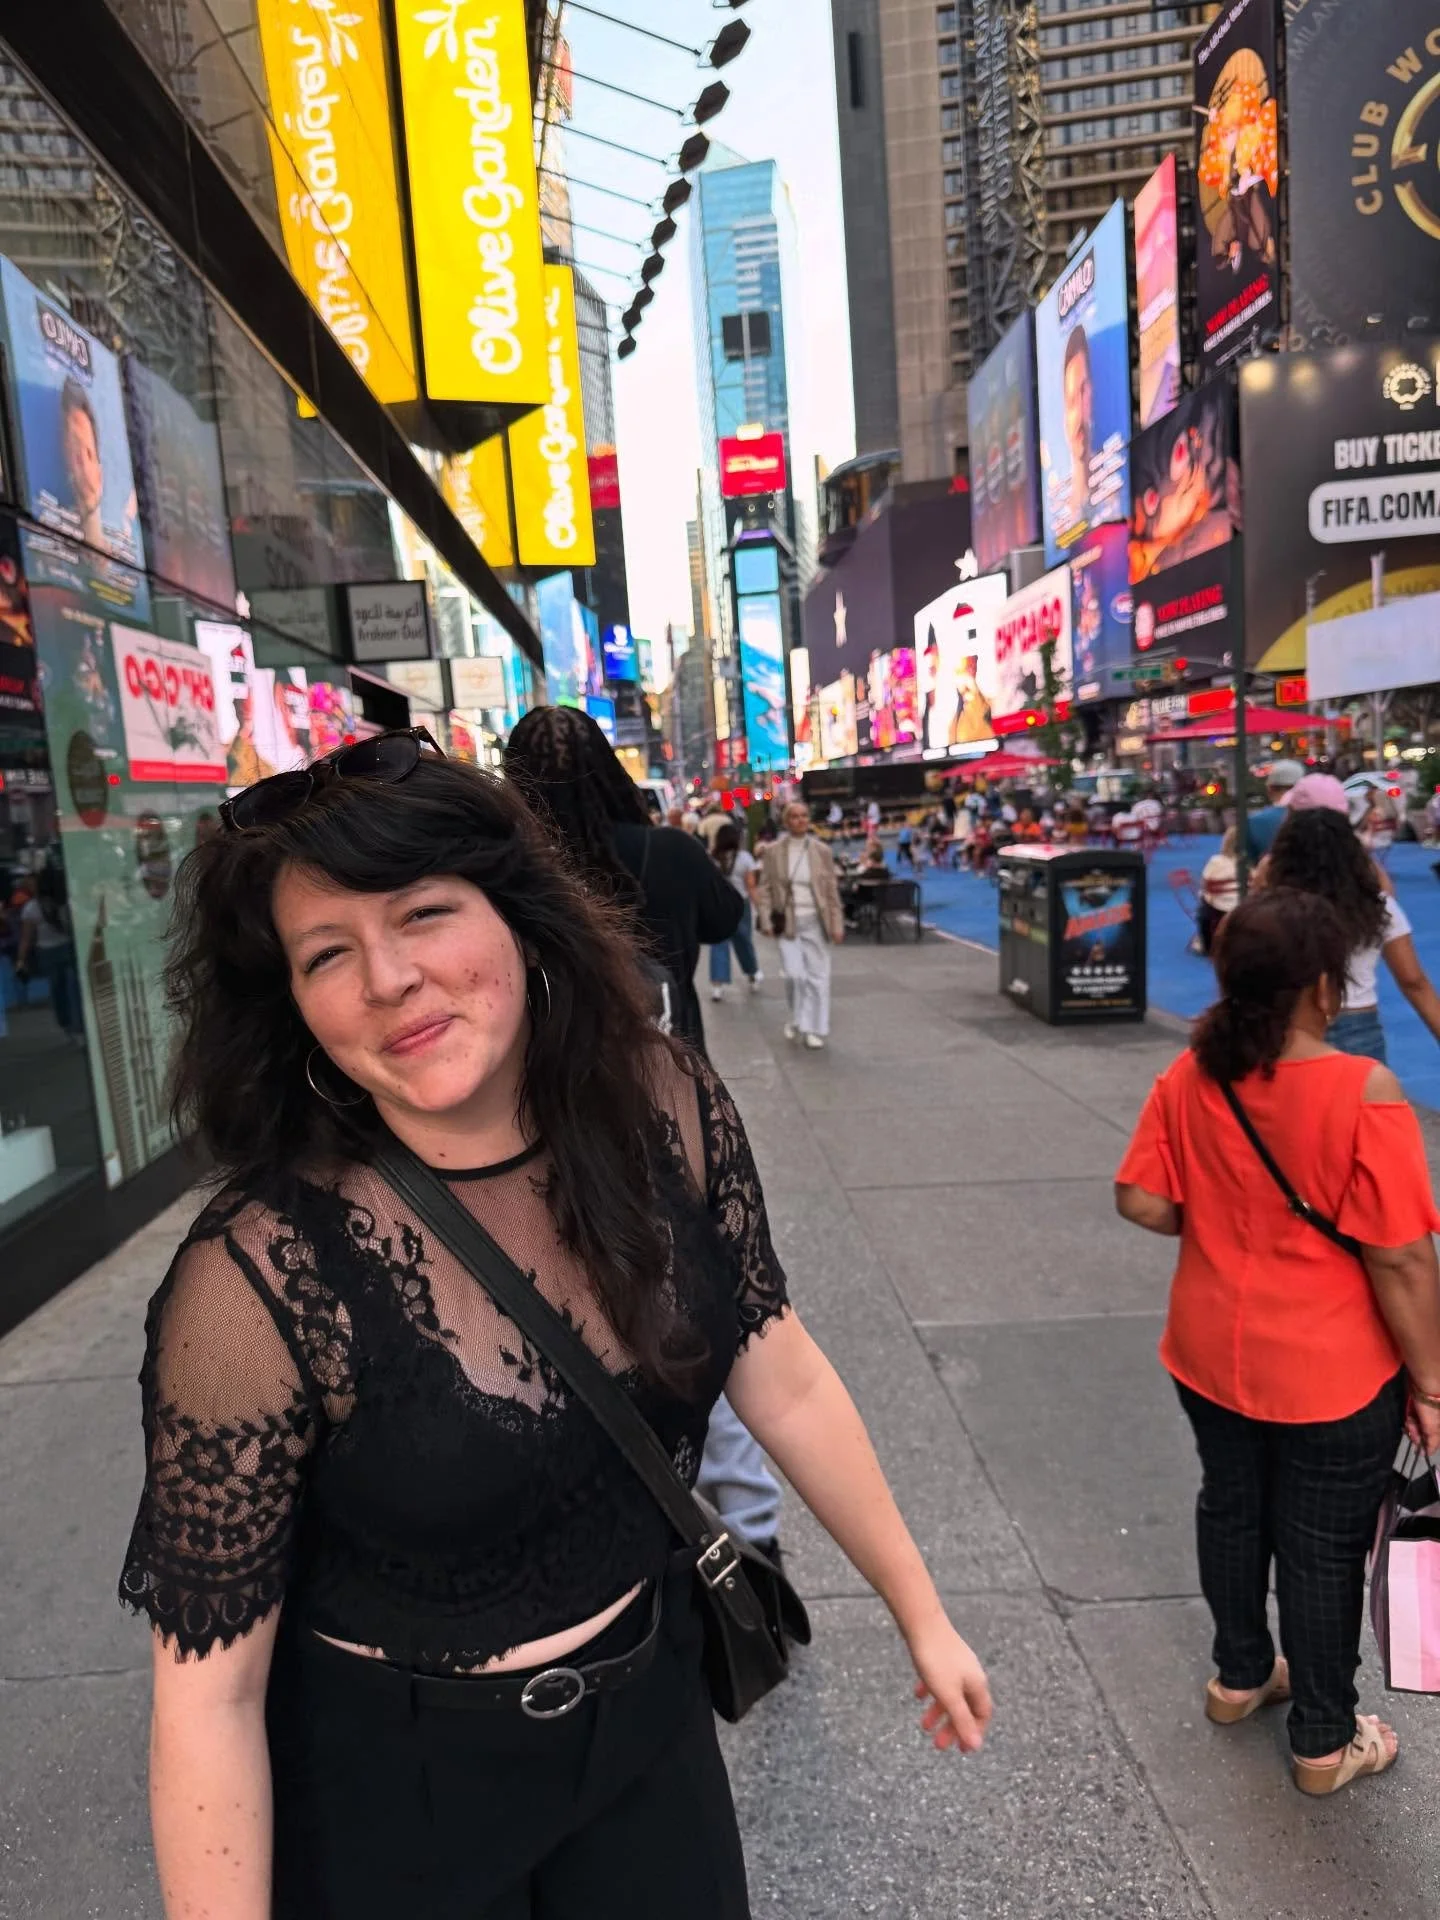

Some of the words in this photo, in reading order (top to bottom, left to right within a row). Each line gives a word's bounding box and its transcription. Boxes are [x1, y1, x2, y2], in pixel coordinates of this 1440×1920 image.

[454, 16, 524, 229] Garden
[1352, 101, 1390, 215] CLUB
[468, 232, 524, 375] Olive
[1334, 435, 1380, 470] BUY
[1383, 429, 1440, 465] TICKE
